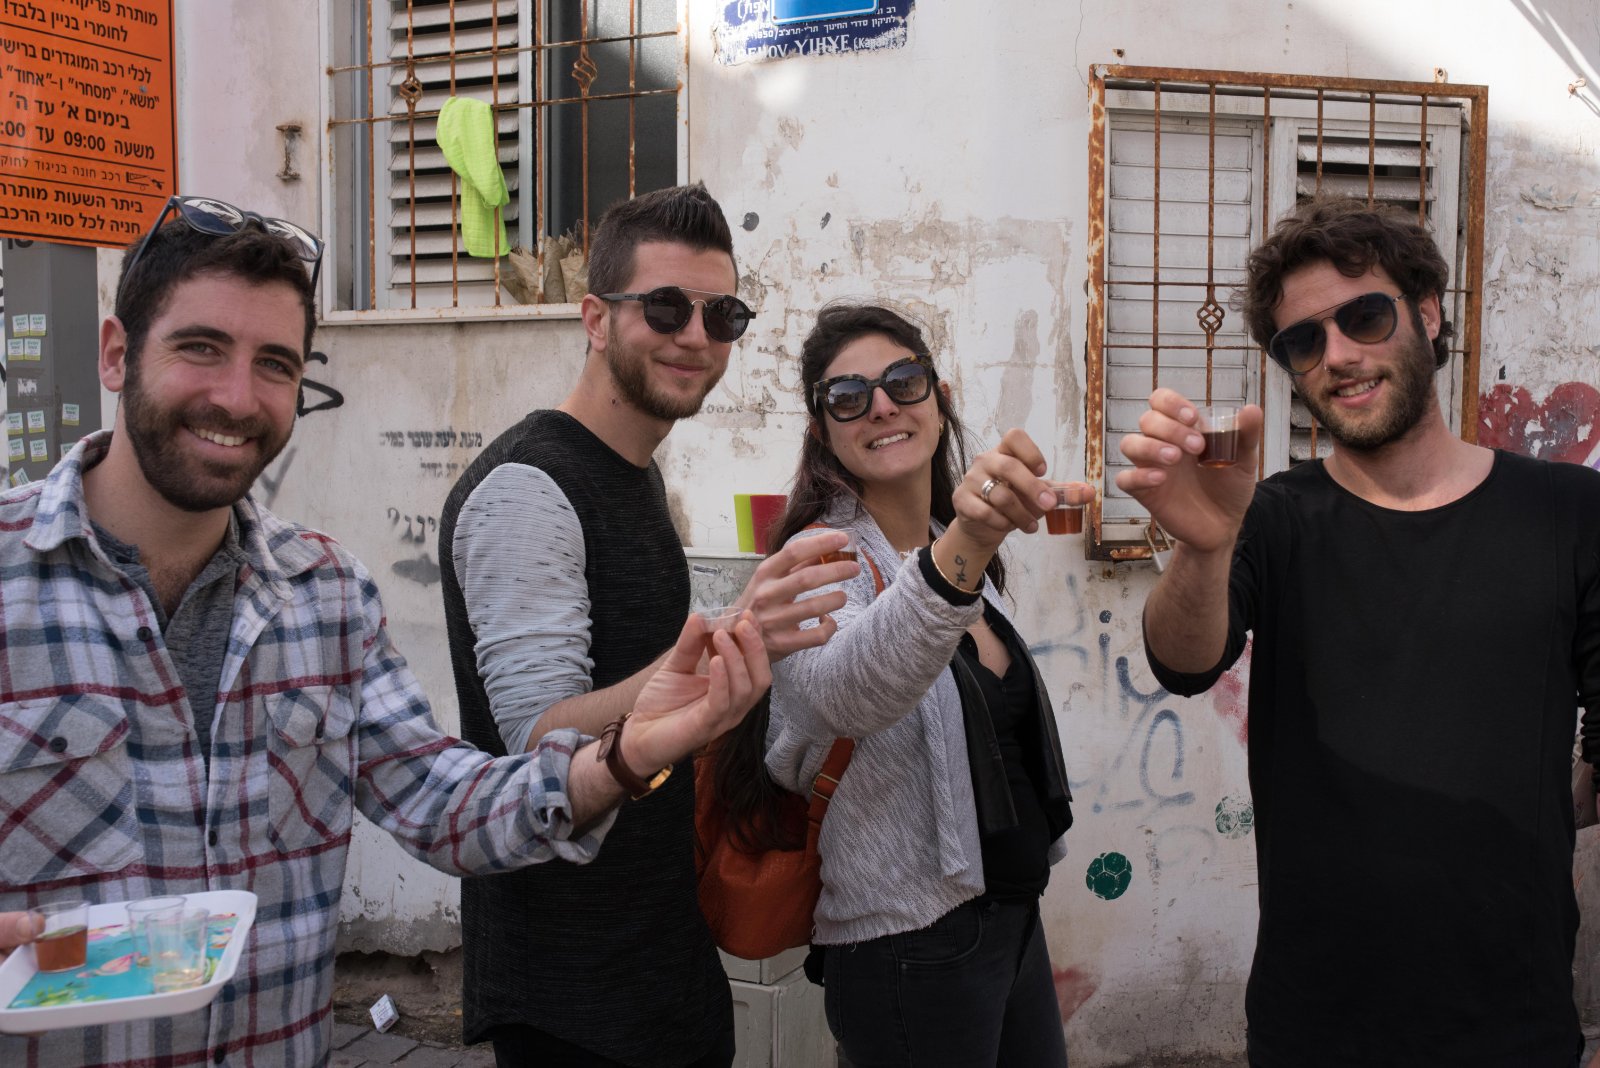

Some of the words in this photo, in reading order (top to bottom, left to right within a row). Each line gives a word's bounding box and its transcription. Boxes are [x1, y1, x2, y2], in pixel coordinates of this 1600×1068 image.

[4, 0, 46, 23] בלבד!
[116, 3, 158, 26] מותרת
[51, 12, 80, 31] בניין
[84, 20, 128, 42] לחומרי
[794, 34, 850, 56] YIHYE
[41, 47, 99, 72] המוגדרים
[103, 61, 125, 78] רכב
[127, 63, 151, 83] לכלי
[34, 99, 55, 116] עד
[85, 108, 130, 130] בימים
[35, 125, 55, 144] עד
[64, 130, 106, 152] 09:00
[114, 140, 155, 160] משעה
[34, 160, 67, 174] בניגוד
[72, 166, 96, 178] חונה
[101, 171, 121, 182] רכב
[54, 190, 106, 208] השעות
[110, 198, 144, 213] ביתר
[46, 211, 74, 227] סוגי
[79, 212, 105, 230] לכל
[110, 219, 141, 234] חניה
